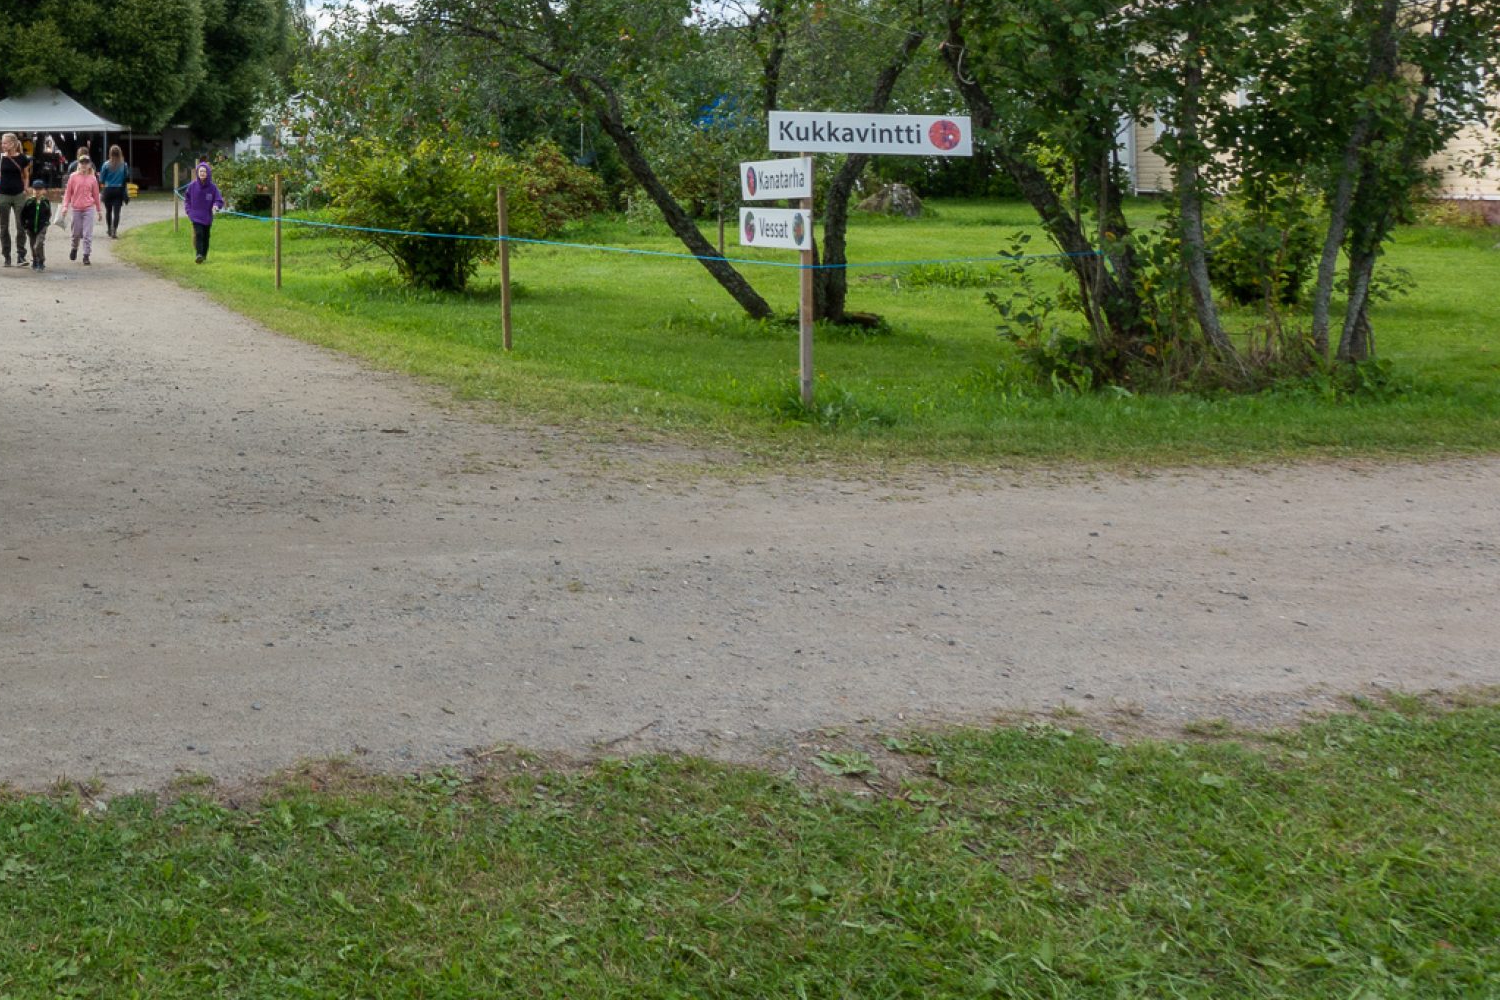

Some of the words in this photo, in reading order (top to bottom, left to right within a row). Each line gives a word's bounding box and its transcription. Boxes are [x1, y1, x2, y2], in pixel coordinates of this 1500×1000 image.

[779, 120, 922, 144] Kukkavintti
[758, 167, 805, 190] Kanatarha
[759, 217, 789, 239] Vessat
